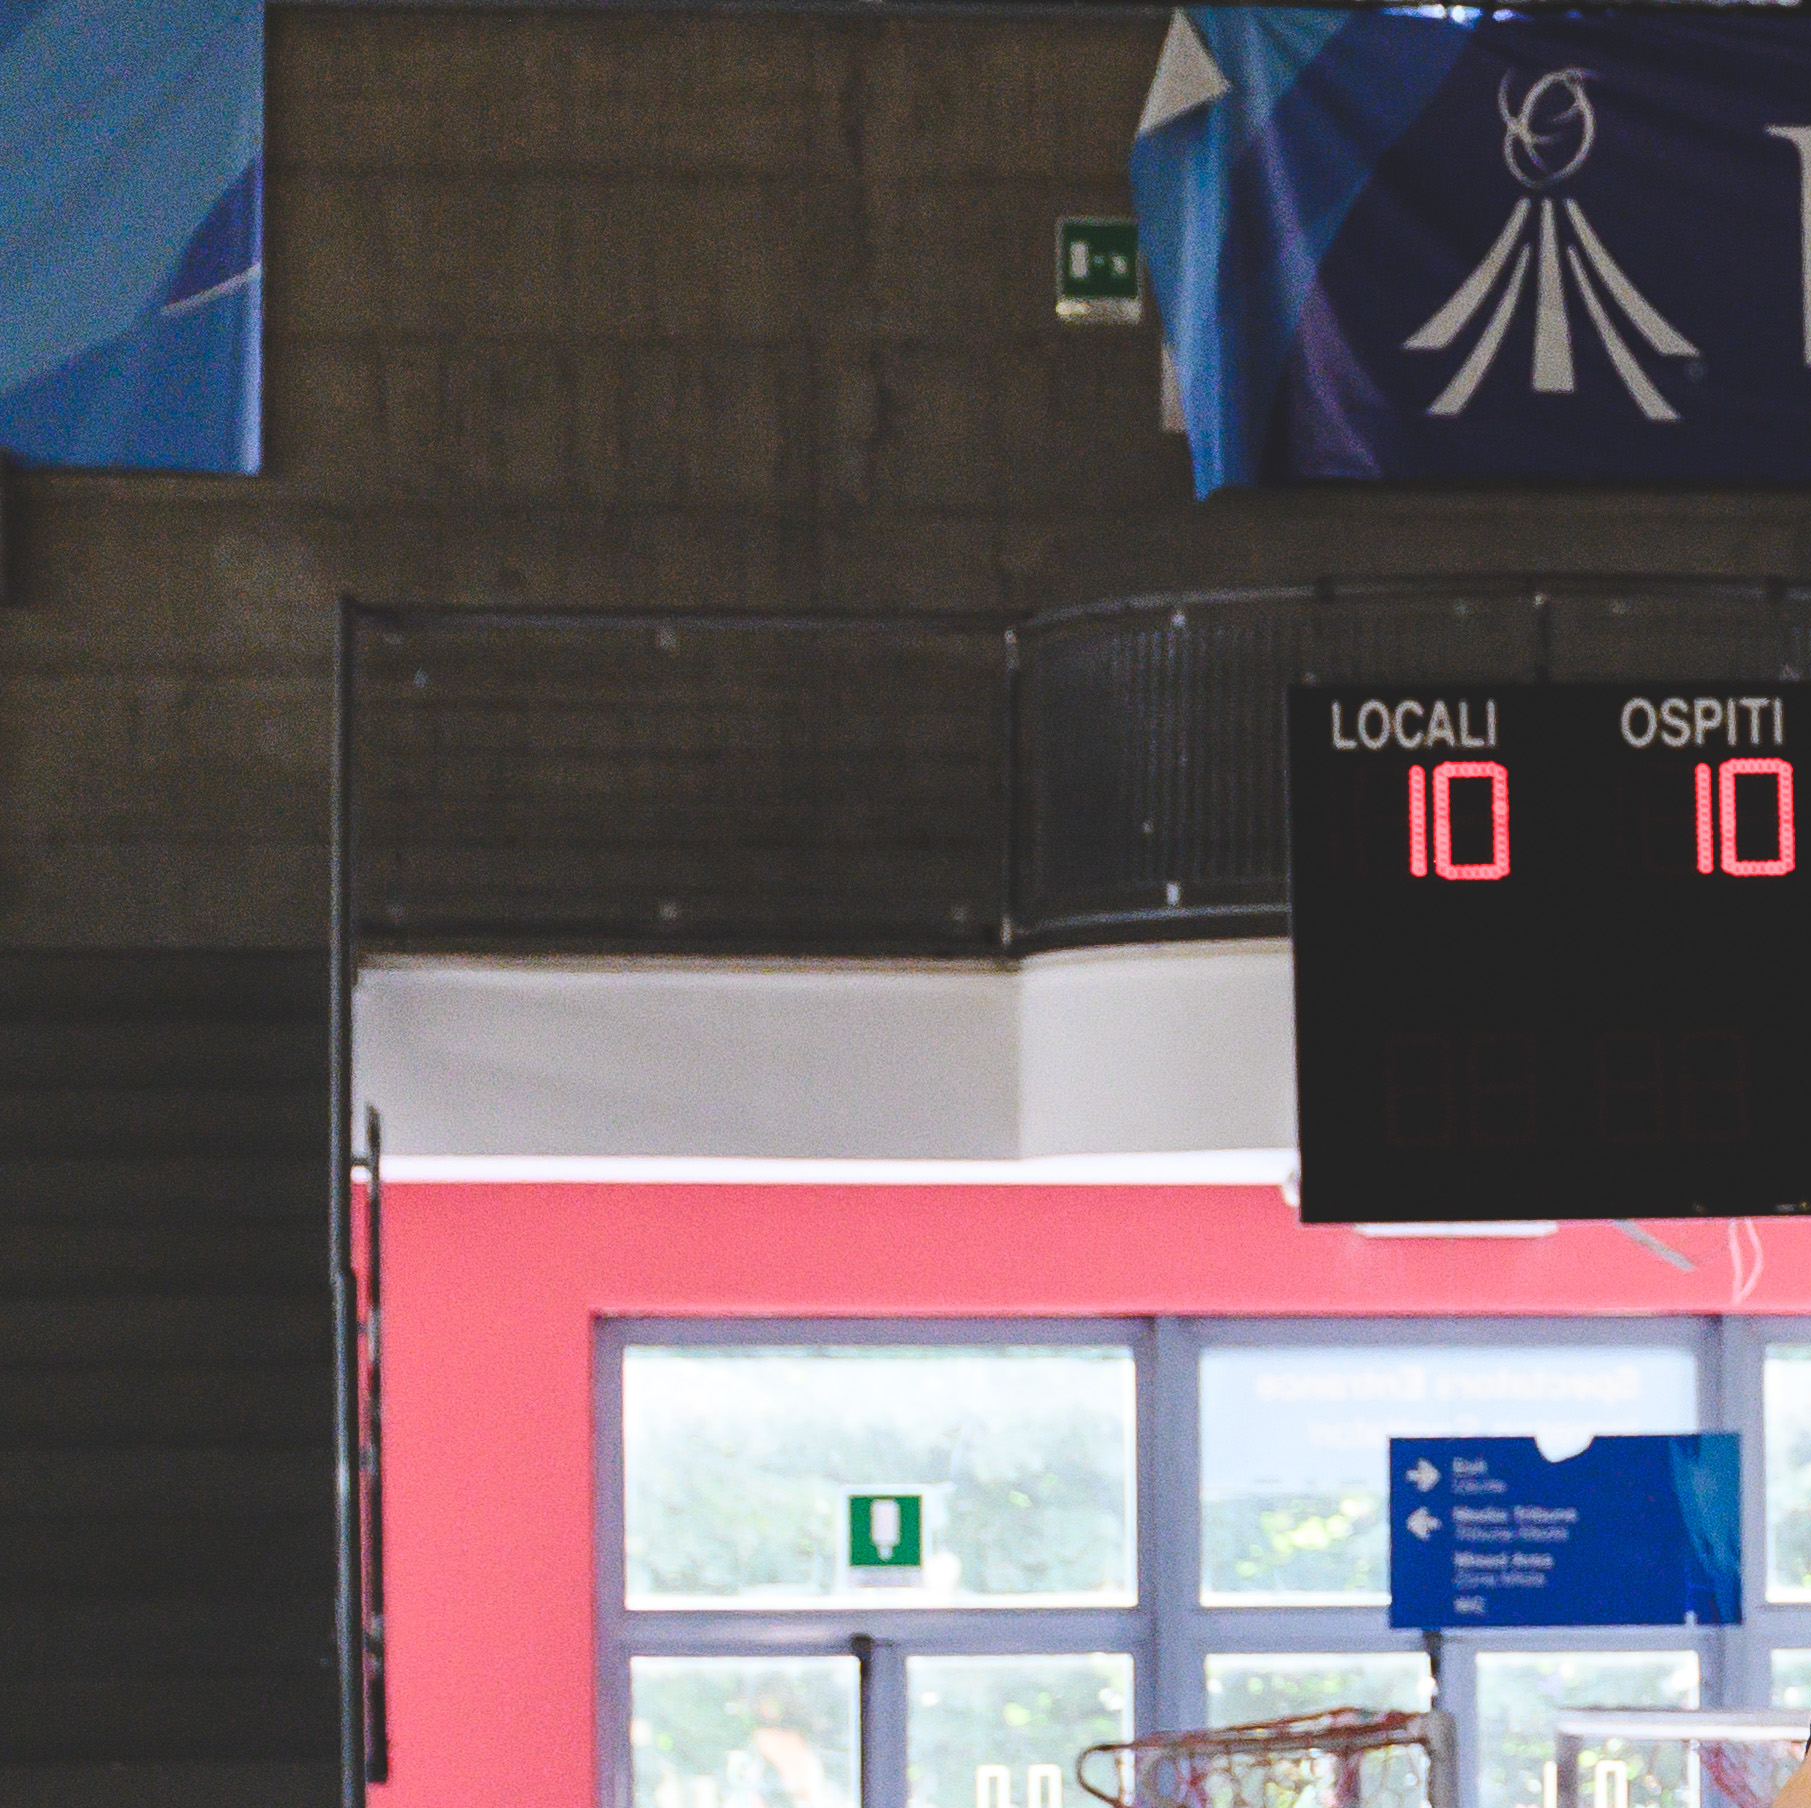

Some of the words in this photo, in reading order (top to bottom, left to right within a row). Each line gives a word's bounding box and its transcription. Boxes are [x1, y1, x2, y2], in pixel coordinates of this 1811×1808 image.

[1331, 699, 1498, 750] LOCALI
[1620, 697, 1784, 748] OSPITI
[1408, 761, 1510, 880] 10
[1695, 757, 1795, 876] 10
